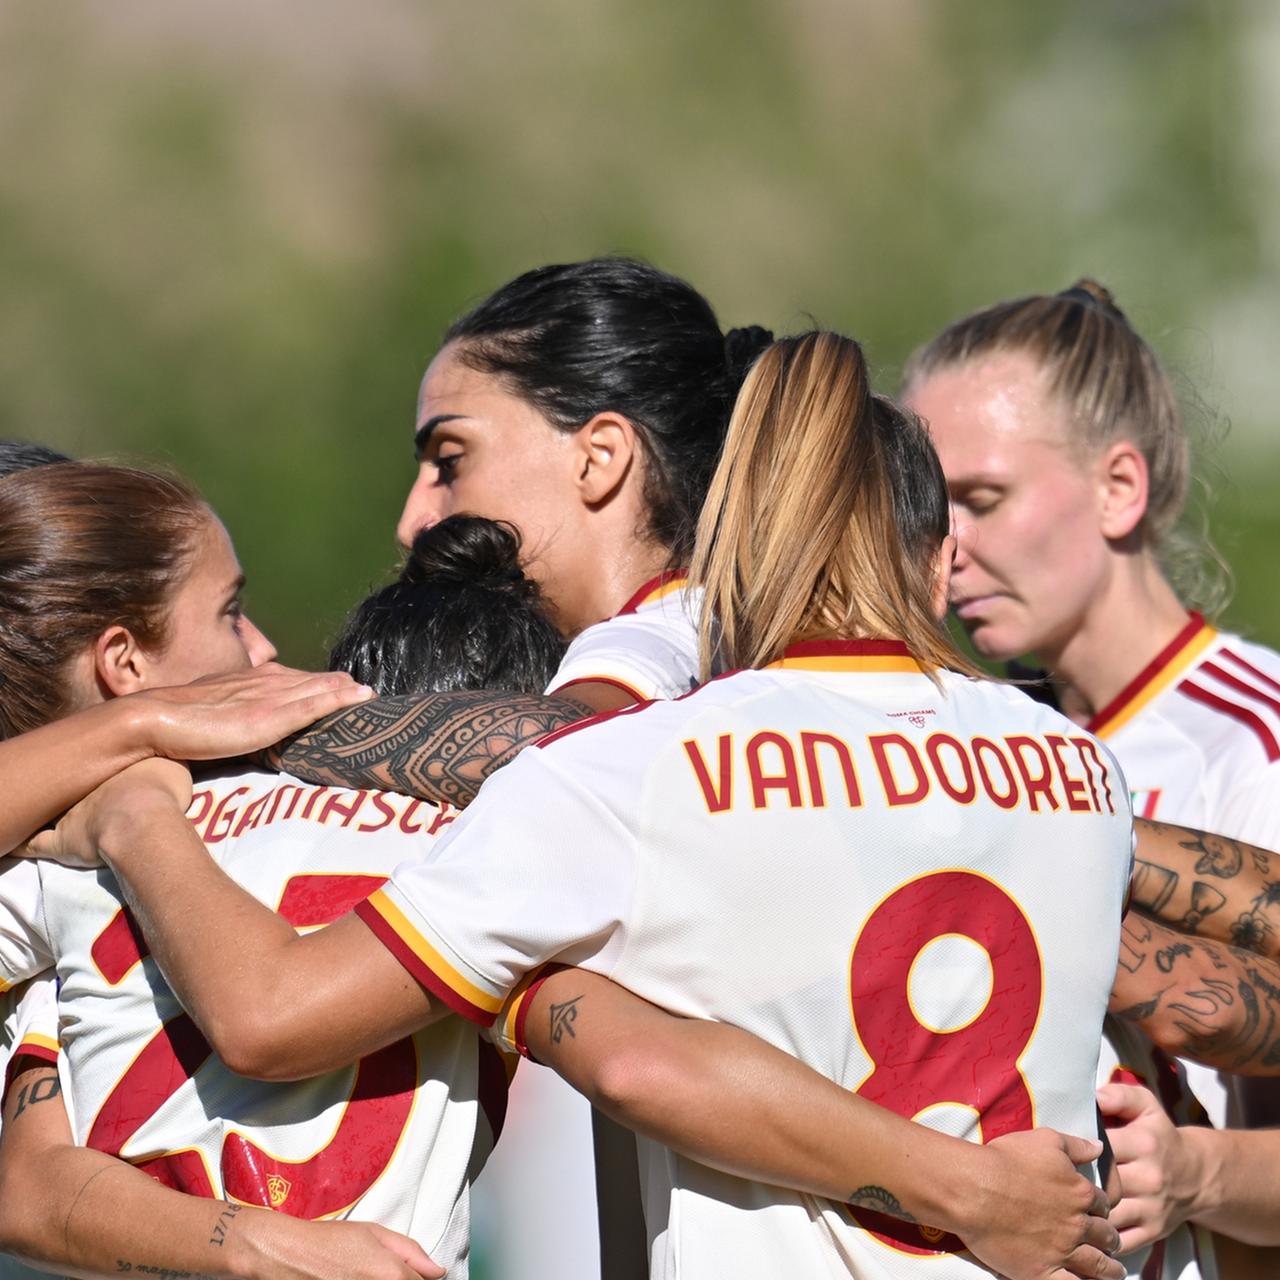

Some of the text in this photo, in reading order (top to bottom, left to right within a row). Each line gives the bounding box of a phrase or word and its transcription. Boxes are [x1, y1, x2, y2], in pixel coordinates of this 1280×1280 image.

[683, 730, 1117, 816] VAN DOOREN
[850, 867, 1044, 1259] 8
